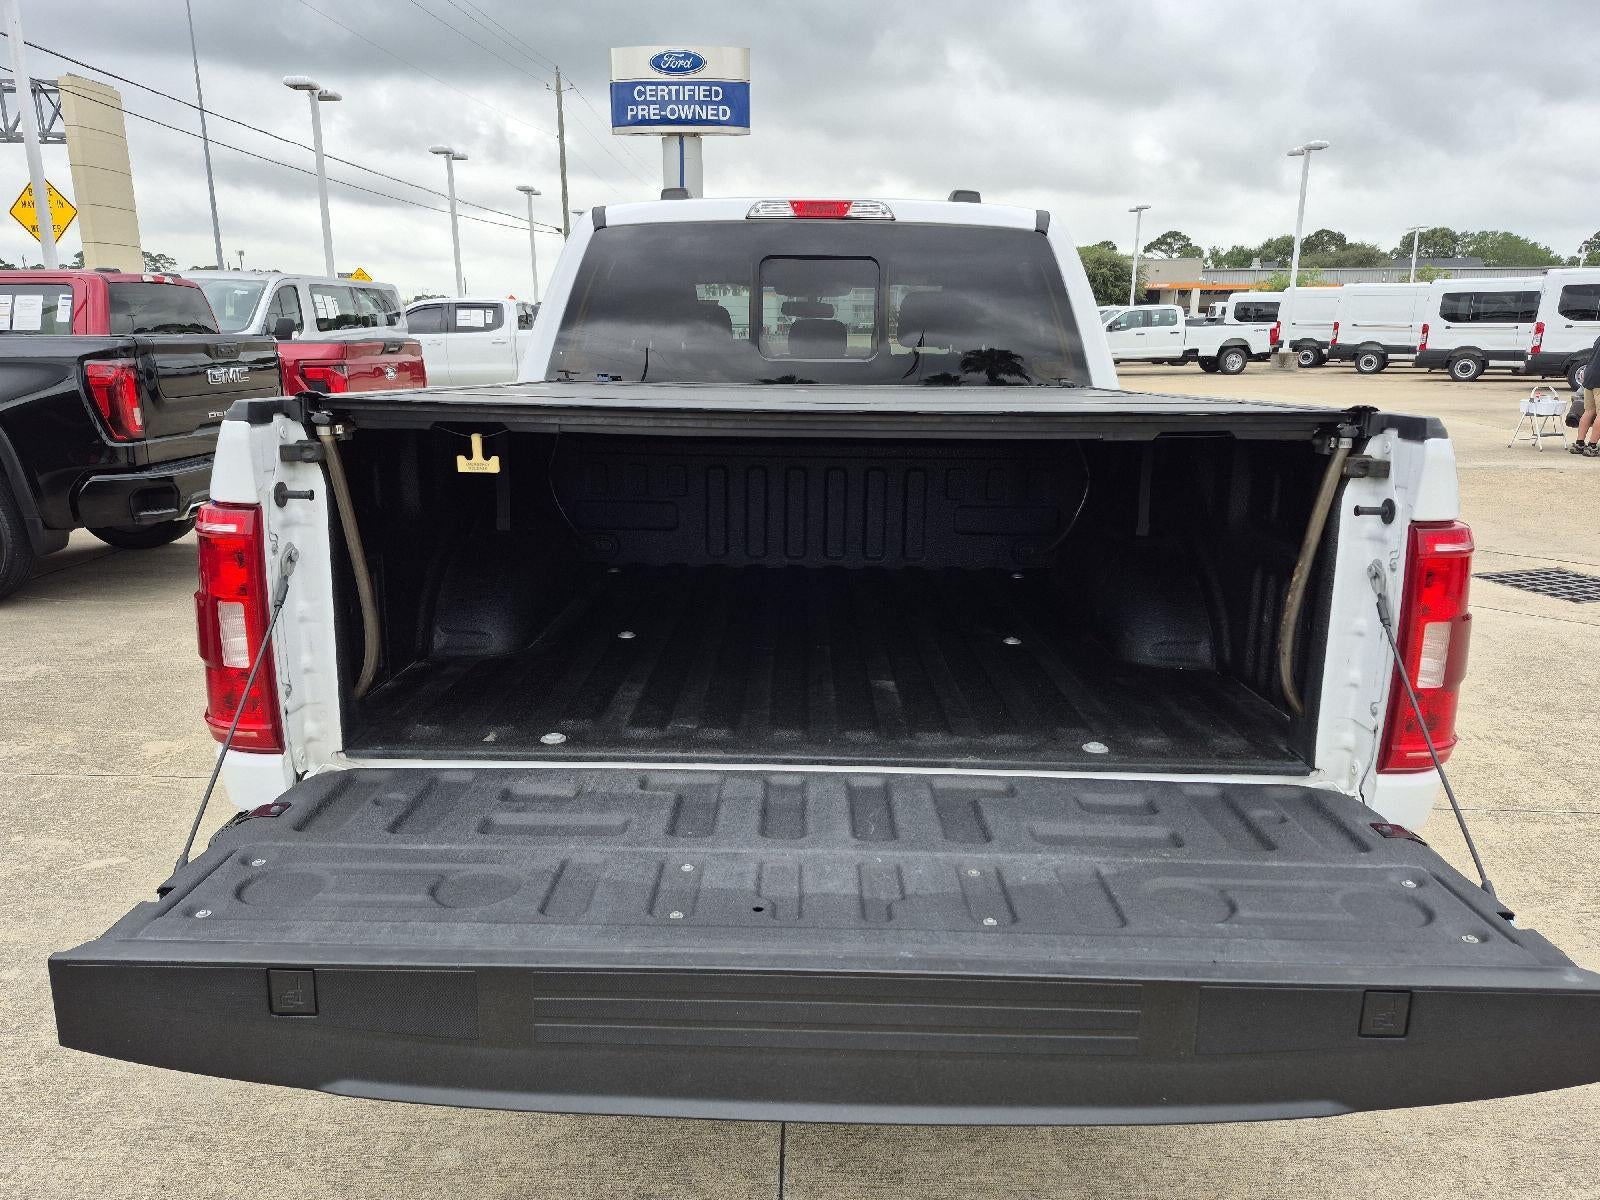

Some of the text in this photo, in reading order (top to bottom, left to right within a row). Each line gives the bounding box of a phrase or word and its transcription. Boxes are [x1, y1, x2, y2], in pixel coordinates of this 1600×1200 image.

[661, 53, 693, 69] Ford
[633, 85, 723, 102] CERTIFIED
[627, 104, 731, 121] PRE-OWNED
[207, 367, 250, 385] GMC
